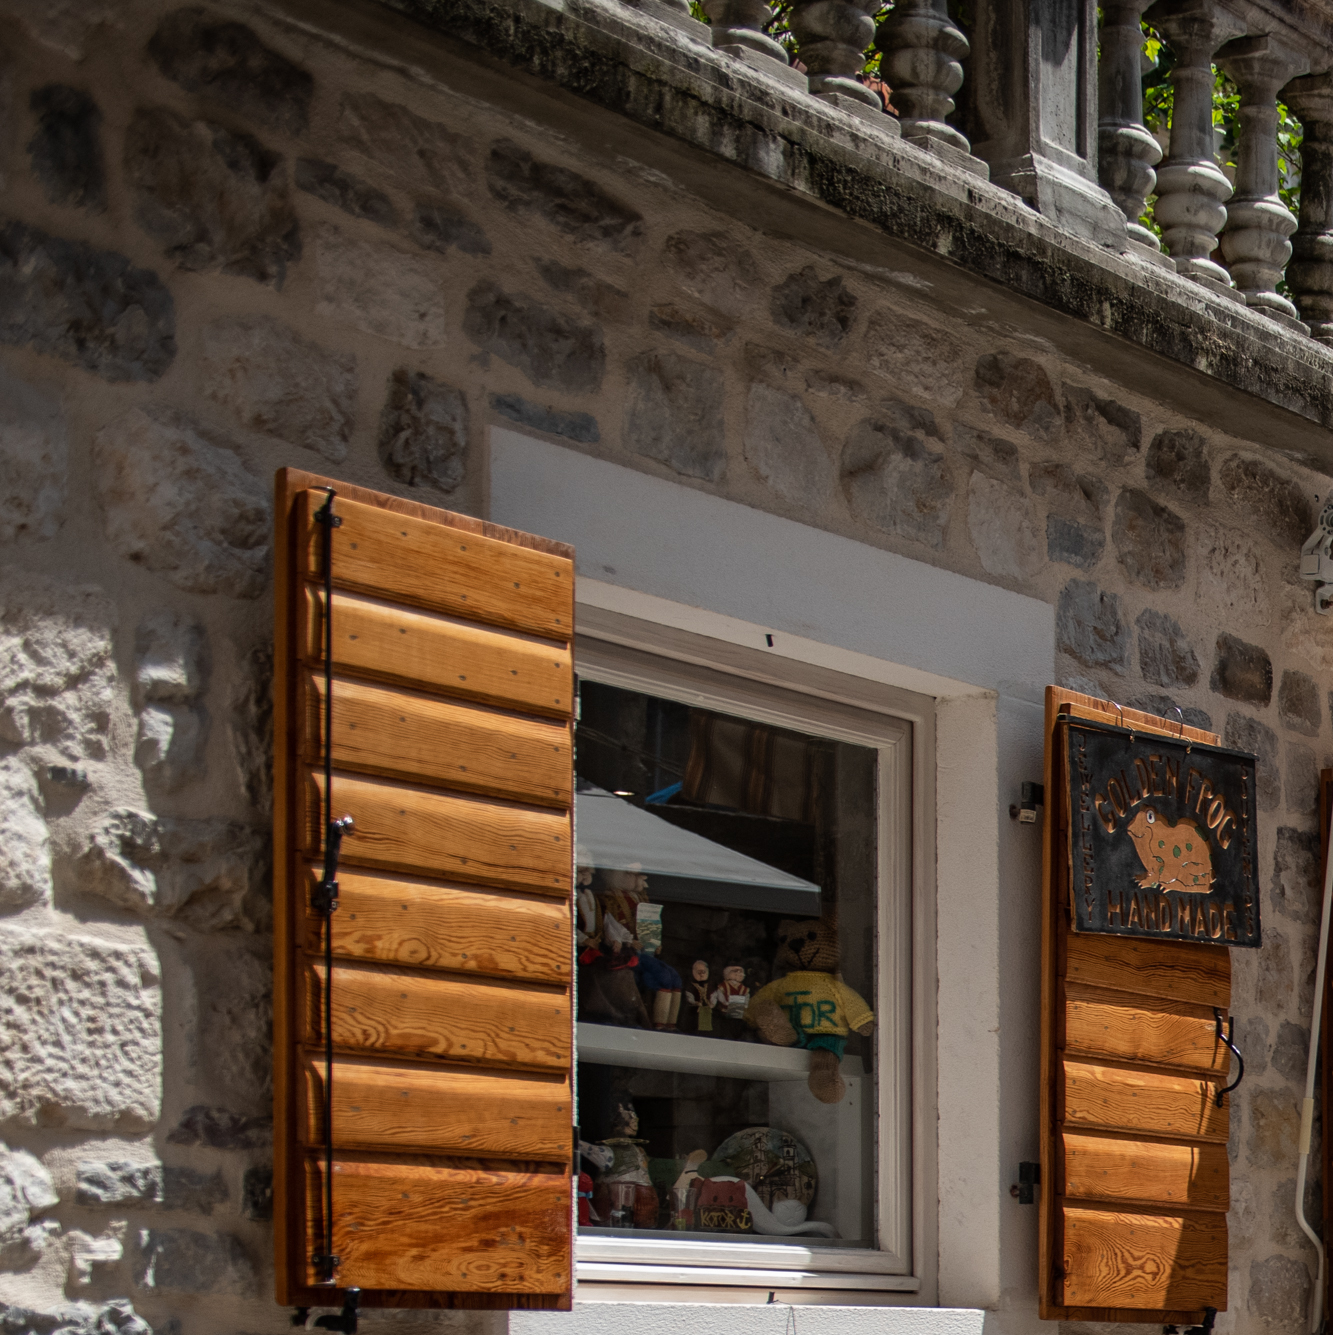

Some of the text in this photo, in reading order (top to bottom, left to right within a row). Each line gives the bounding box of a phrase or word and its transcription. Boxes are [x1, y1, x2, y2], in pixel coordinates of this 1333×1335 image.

[1077, 733, 1096, 923] JEWELLERY
[1095, 754, 1237, 850] GOLDEN FROG
[1240, 762, 1254, 937] SOUVENIRS
[1106, 890, 1238, 940] HAND MADE
[700, 1209, 735, 1228] KOTOR
